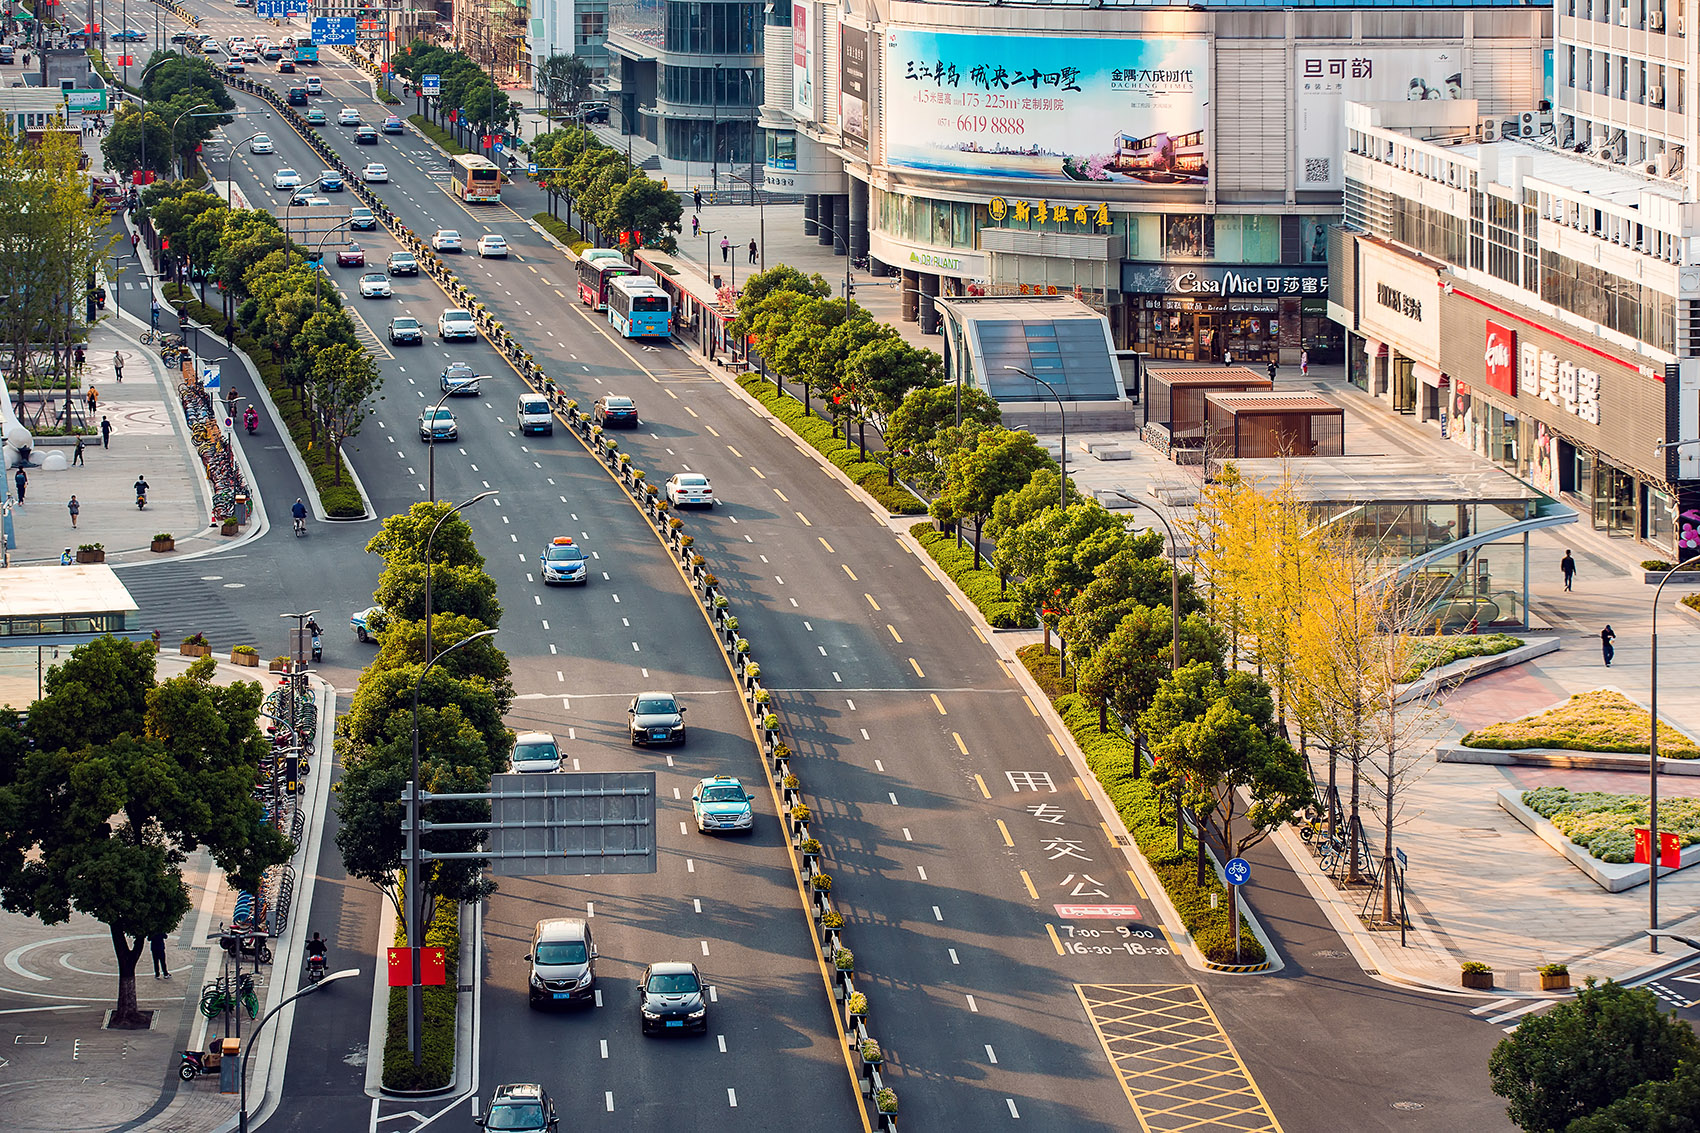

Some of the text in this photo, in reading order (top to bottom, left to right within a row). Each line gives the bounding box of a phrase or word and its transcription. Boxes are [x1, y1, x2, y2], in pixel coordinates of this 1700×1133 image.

[1303, 57, 1373, 79] 旦可韵
[1175, 270, 1220, 293] Casa
[1253, 304, 1274, 312] Drinks
[1521, 342, 1600, 426] 国美电器
[1004, 771, 1058, 793] 用
[1026, 803, 1066, 825] 专
[1040, 837, 1093, 861] 交
[1059, 874, 1110, 898] 公
